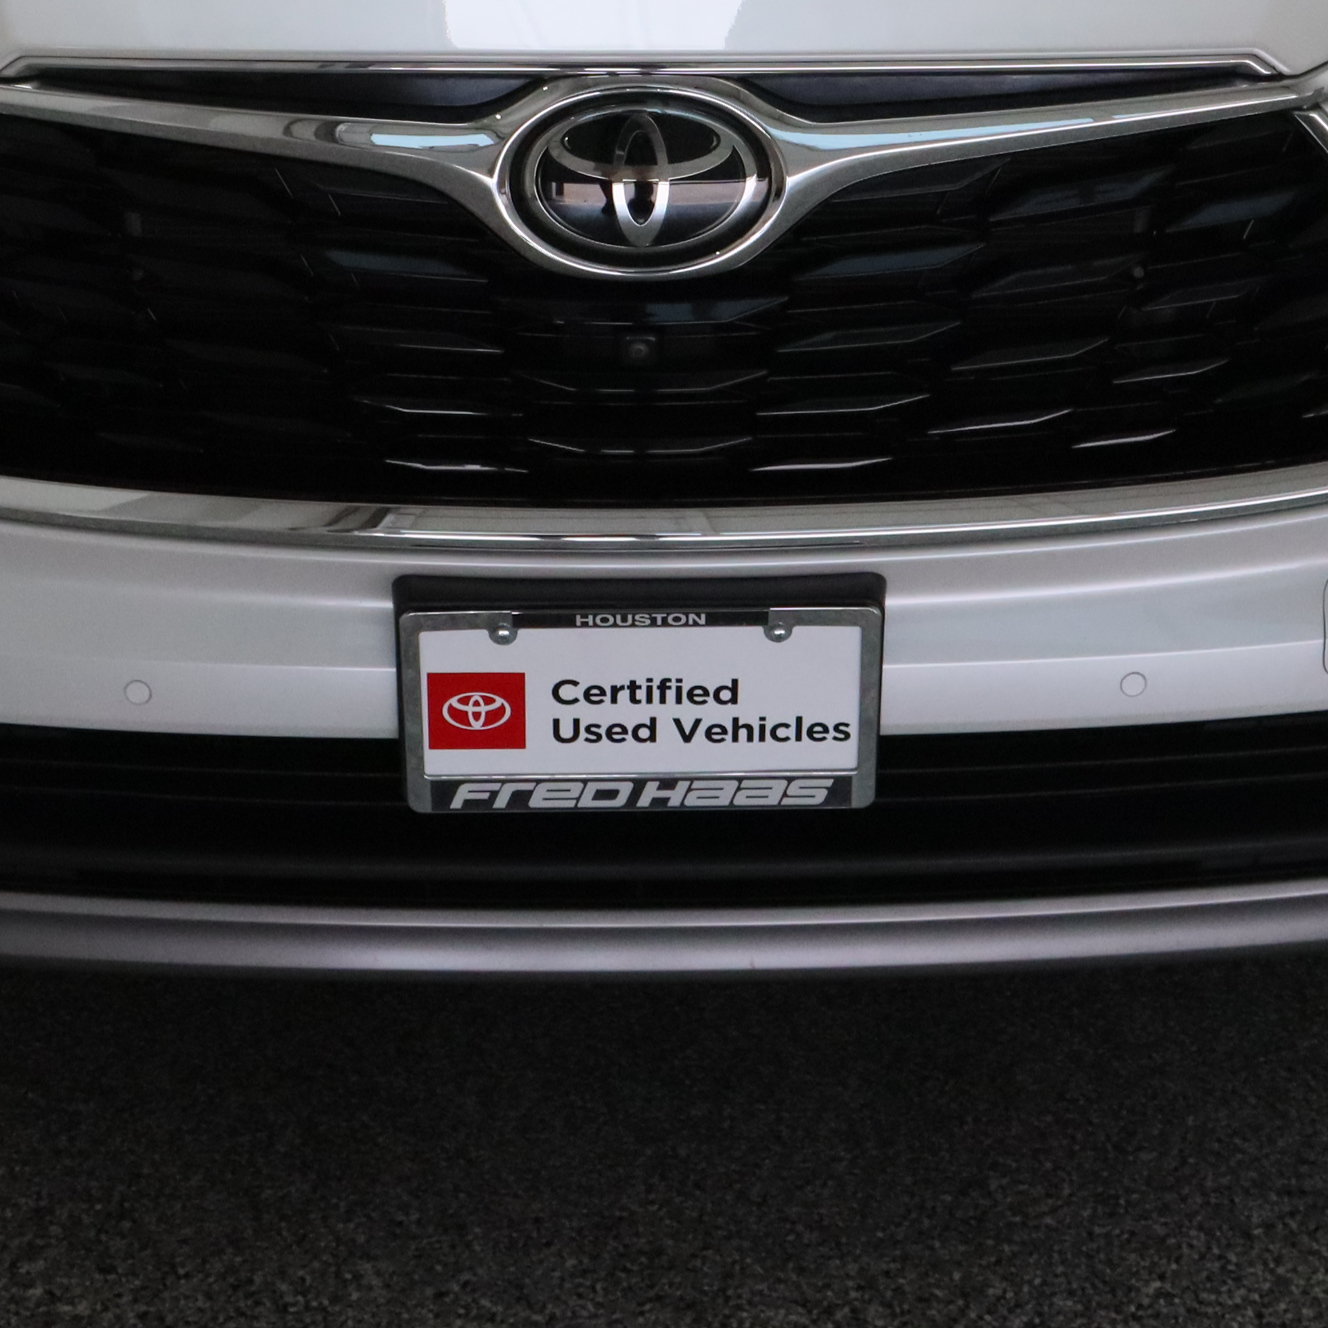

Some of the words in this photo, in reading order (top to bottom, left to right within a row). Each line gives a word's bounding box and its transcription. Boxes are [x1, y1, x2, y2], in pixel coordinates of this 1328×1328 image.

[575, 613, 706, 627] HOUSTON
[552, 678, 739, 706] Certified
[552, 717, 657, 744] Used
[673, 716, 852, 743] Vehicles
